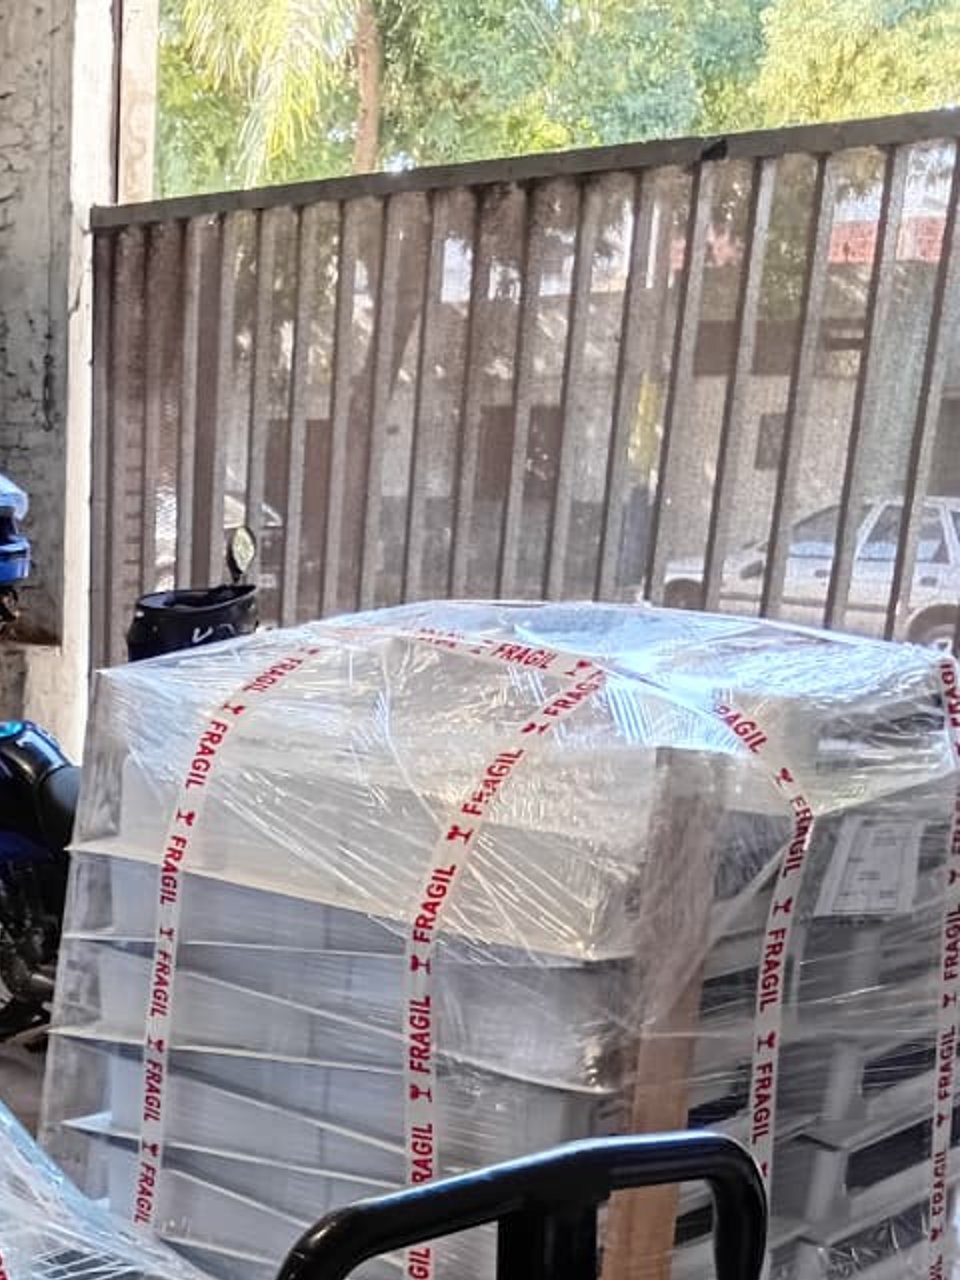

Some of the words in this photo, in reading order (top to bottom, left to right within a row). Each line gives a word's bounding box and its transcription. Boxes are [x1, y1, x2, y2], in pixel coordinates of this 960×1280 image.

[490, 643, 557, 669] FRAGIL
[185, 720, 227, 789] FRAGIL
[160, 835, 187, 904] FRAGIL
[413, 864, 456, 943] FRAGIL
[150, 950, 173, 1016] FRAGIL
[760, 928, 786, 1012] FRAGIL
[410, 995, 431, 1074] FRAGIL
[938, 1026, 955, 1100] FRAGIL
[144, 1059, 162, 1121] FRAGIL
[752, 1061, 773, 1145] FRAGIL
[411, 1124, 432, 1185] RAGIL
[134, 1162, 157, 1224] FRAGIL
